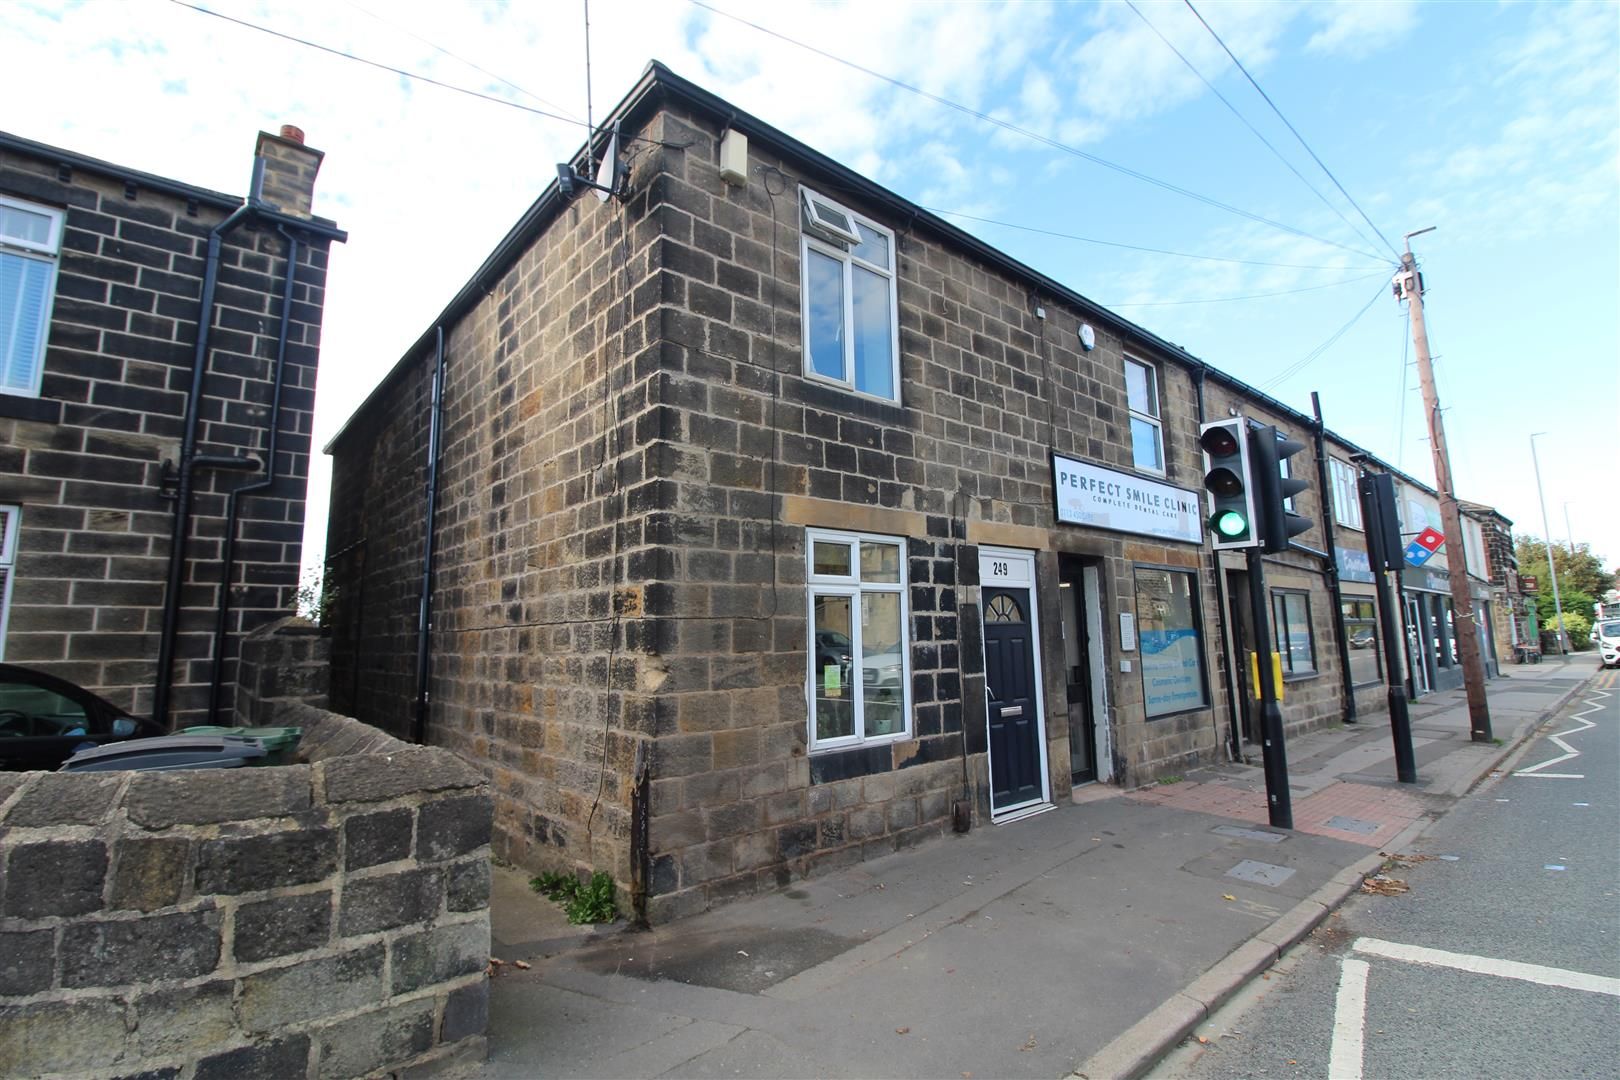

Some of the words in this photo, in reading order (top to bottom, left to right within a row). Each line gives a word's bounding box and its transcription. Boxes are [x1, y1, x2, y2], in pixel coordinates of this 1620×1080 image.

[1060, 471, 1121, 498] PERFECT
[1126, 487, 1160, 507] SMILE
[1164, 496, 1197, 515] CLINIC
[1092, 495, 1130, 509] COMPLETE
[1134, 504, 1159, 515] DENTAL
[993, 561, 1008, 576] 249
